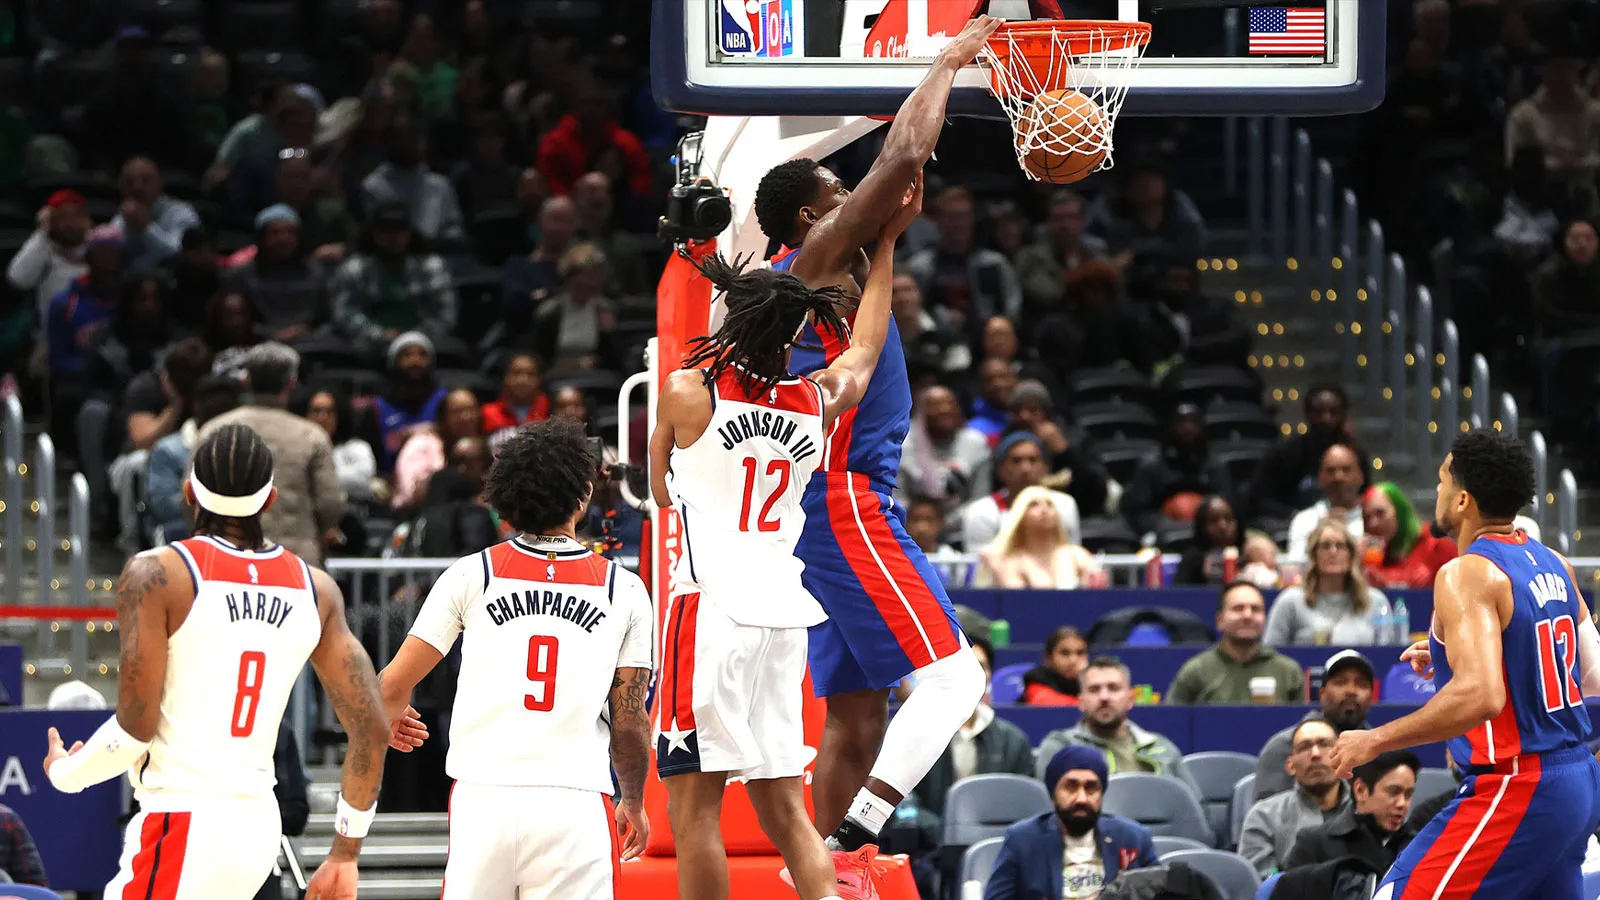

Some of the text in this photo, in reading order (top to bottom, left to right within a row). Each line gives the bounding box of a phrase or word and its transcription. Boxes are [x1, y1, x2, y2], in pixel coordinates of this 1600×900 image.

[726, 33, 746, 48] NBA
[717, 411, 816, 463] JOHNSON III
[739, 457, 791, 532] 12
[536, 535, 552, 543] NIKE
[226, 591, 293, 629] HARDY
[486, 590, 606, 634] CHAMPAGNIE
[524, 635, 559, 712] 9
[1535, 614, 1584, 713] 12
[231, 651, 266, 738] 8
